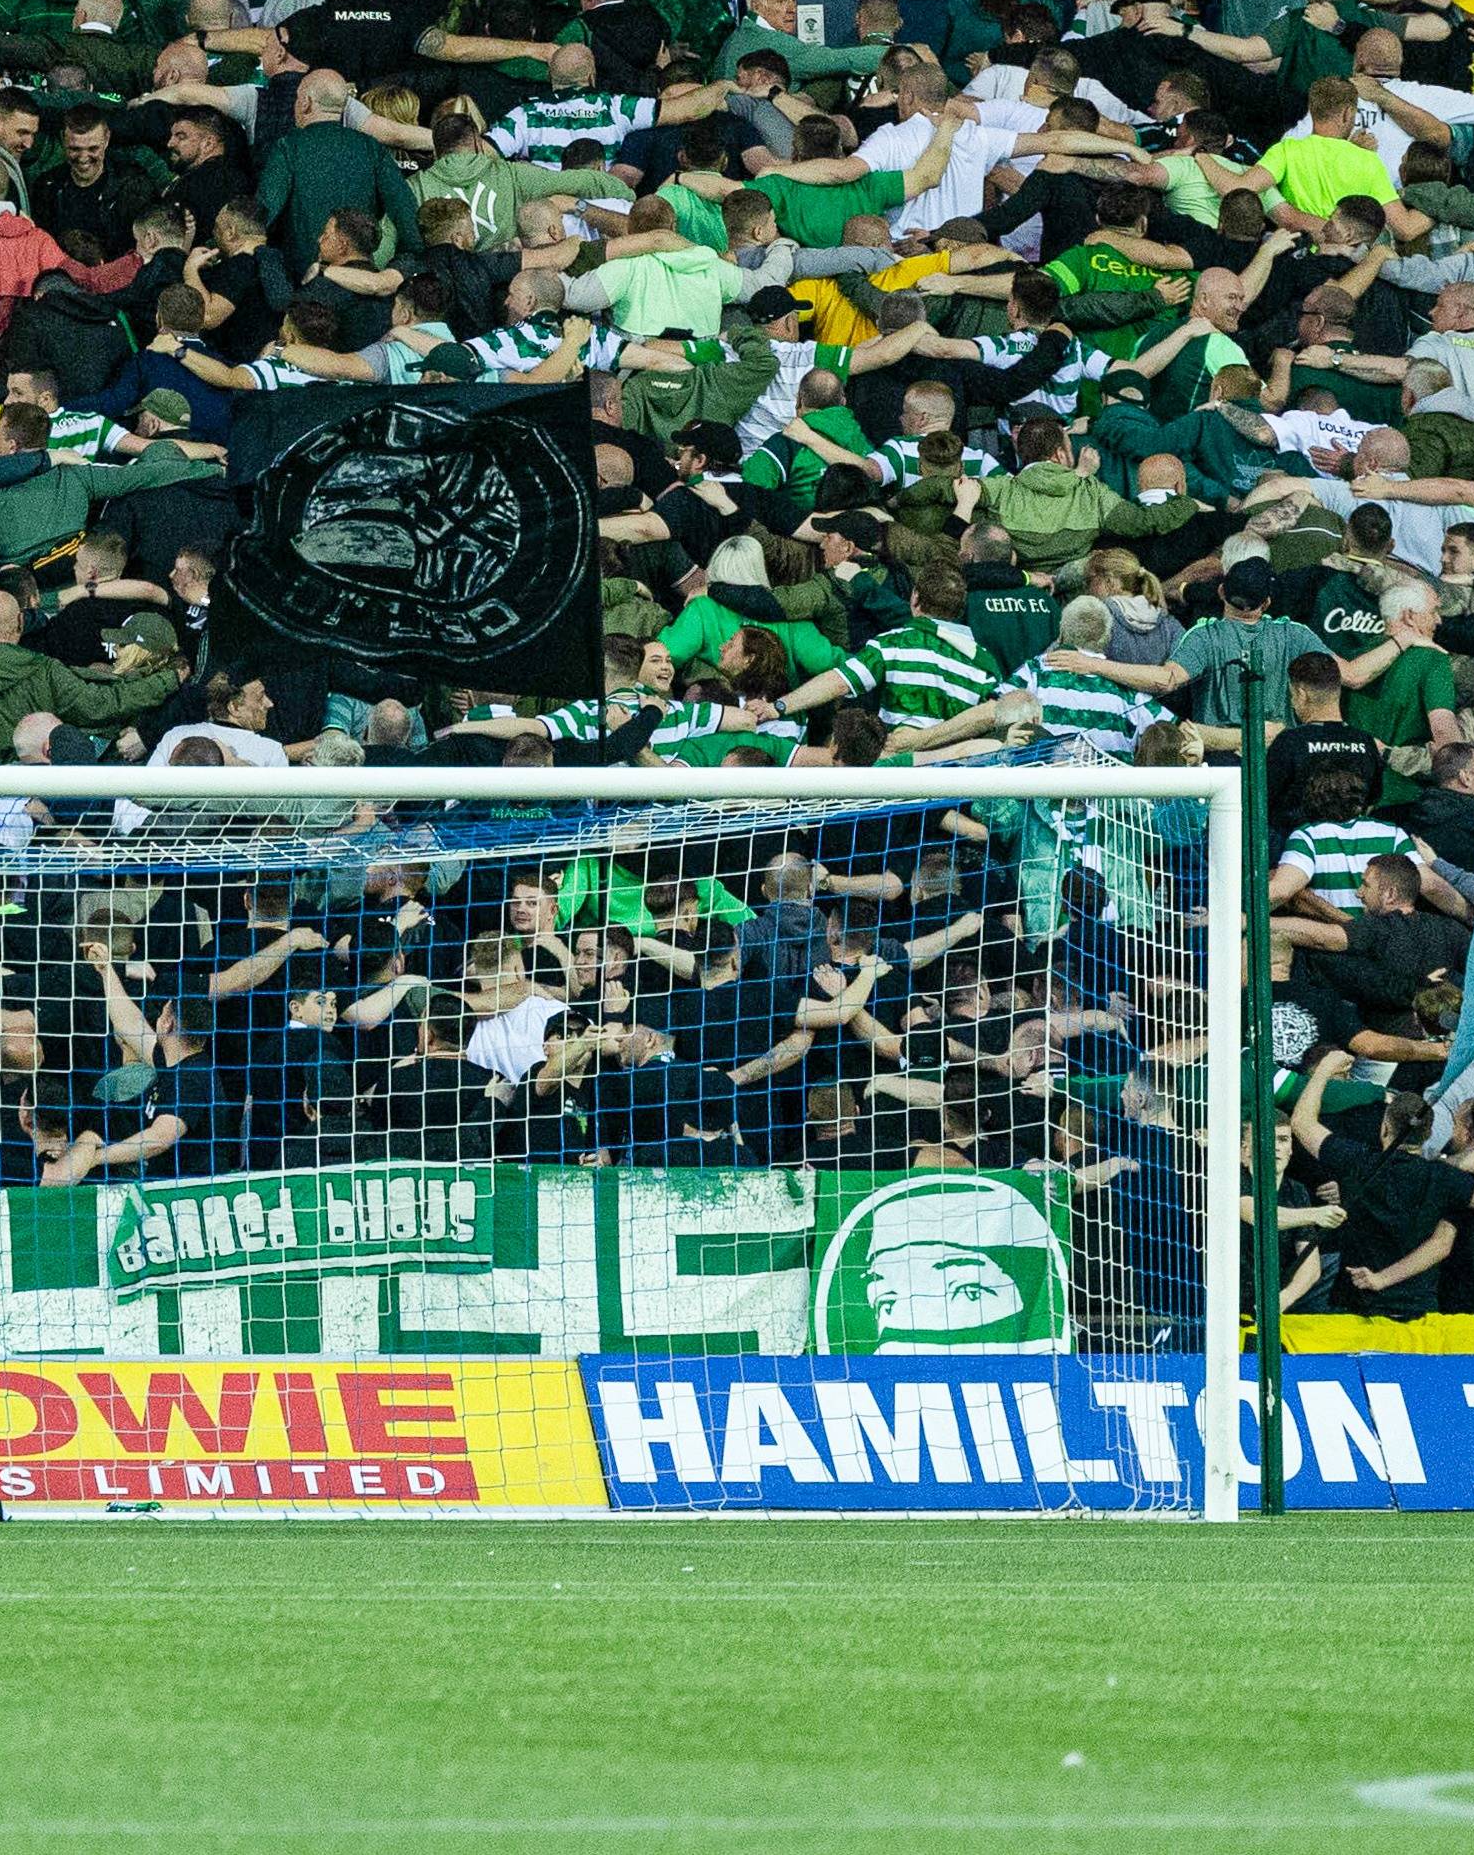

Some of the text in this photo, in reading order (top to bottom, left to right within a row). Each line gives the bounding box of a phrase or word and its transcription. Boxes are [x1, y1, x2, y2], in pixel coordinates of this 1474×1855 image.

[334, 10, 392, 22] MAGNERS
[985, 597, 1026, 614] CELTIC
[1323, 607, 1387, 637] Celtic
[596, 1380, 1428, 1486] HAMILTON
[96, 1464, 448, 1498] LIMITED
